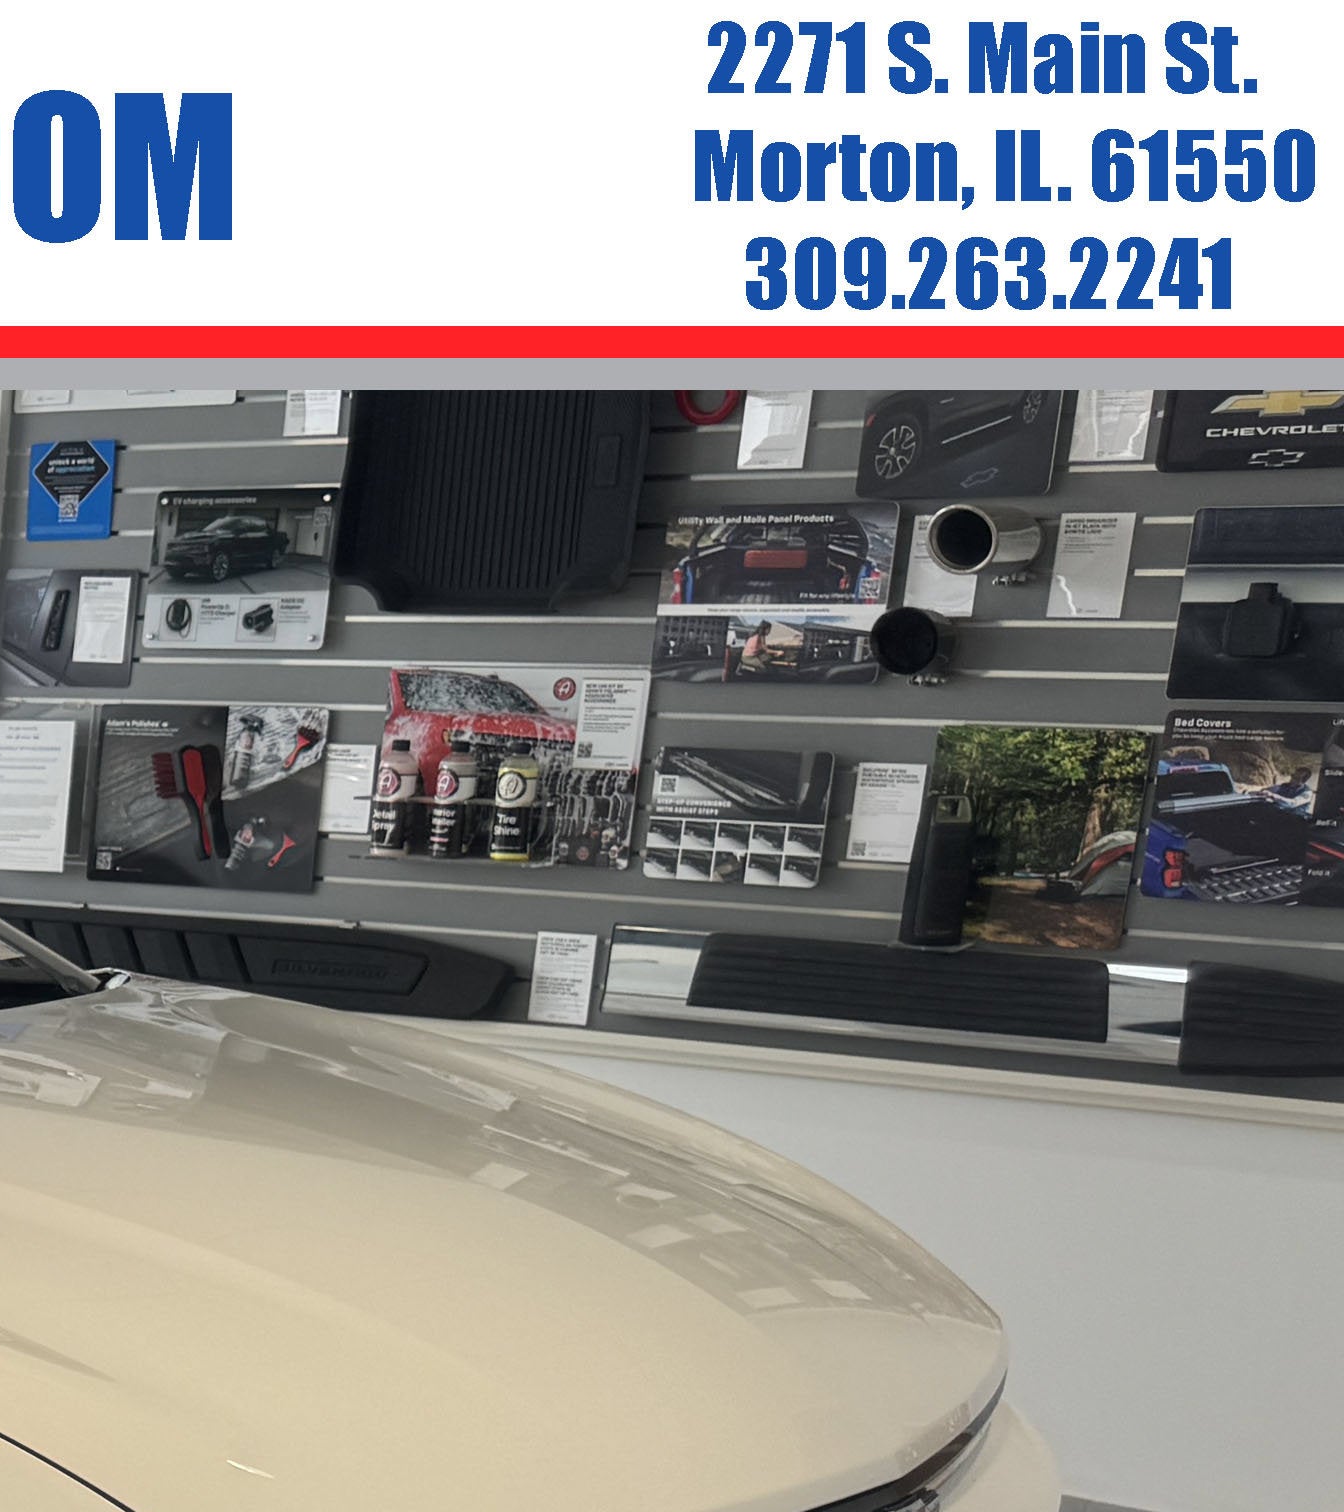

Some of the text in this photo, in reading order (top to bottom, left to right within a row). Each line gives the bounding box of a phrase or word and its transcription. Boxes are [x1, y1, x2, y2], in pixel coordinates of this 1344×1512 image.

[706, 515, 725, 524] Wall
[726, 515, 742, 524] and
[768, 514, 793, 523] Panel
[794, 513, 835, 523] Products
[1174, 717, 1232, 728] Bed Covers
[497, 813, 516, 825] Tire
[493, 824, 520, 837] Shine
